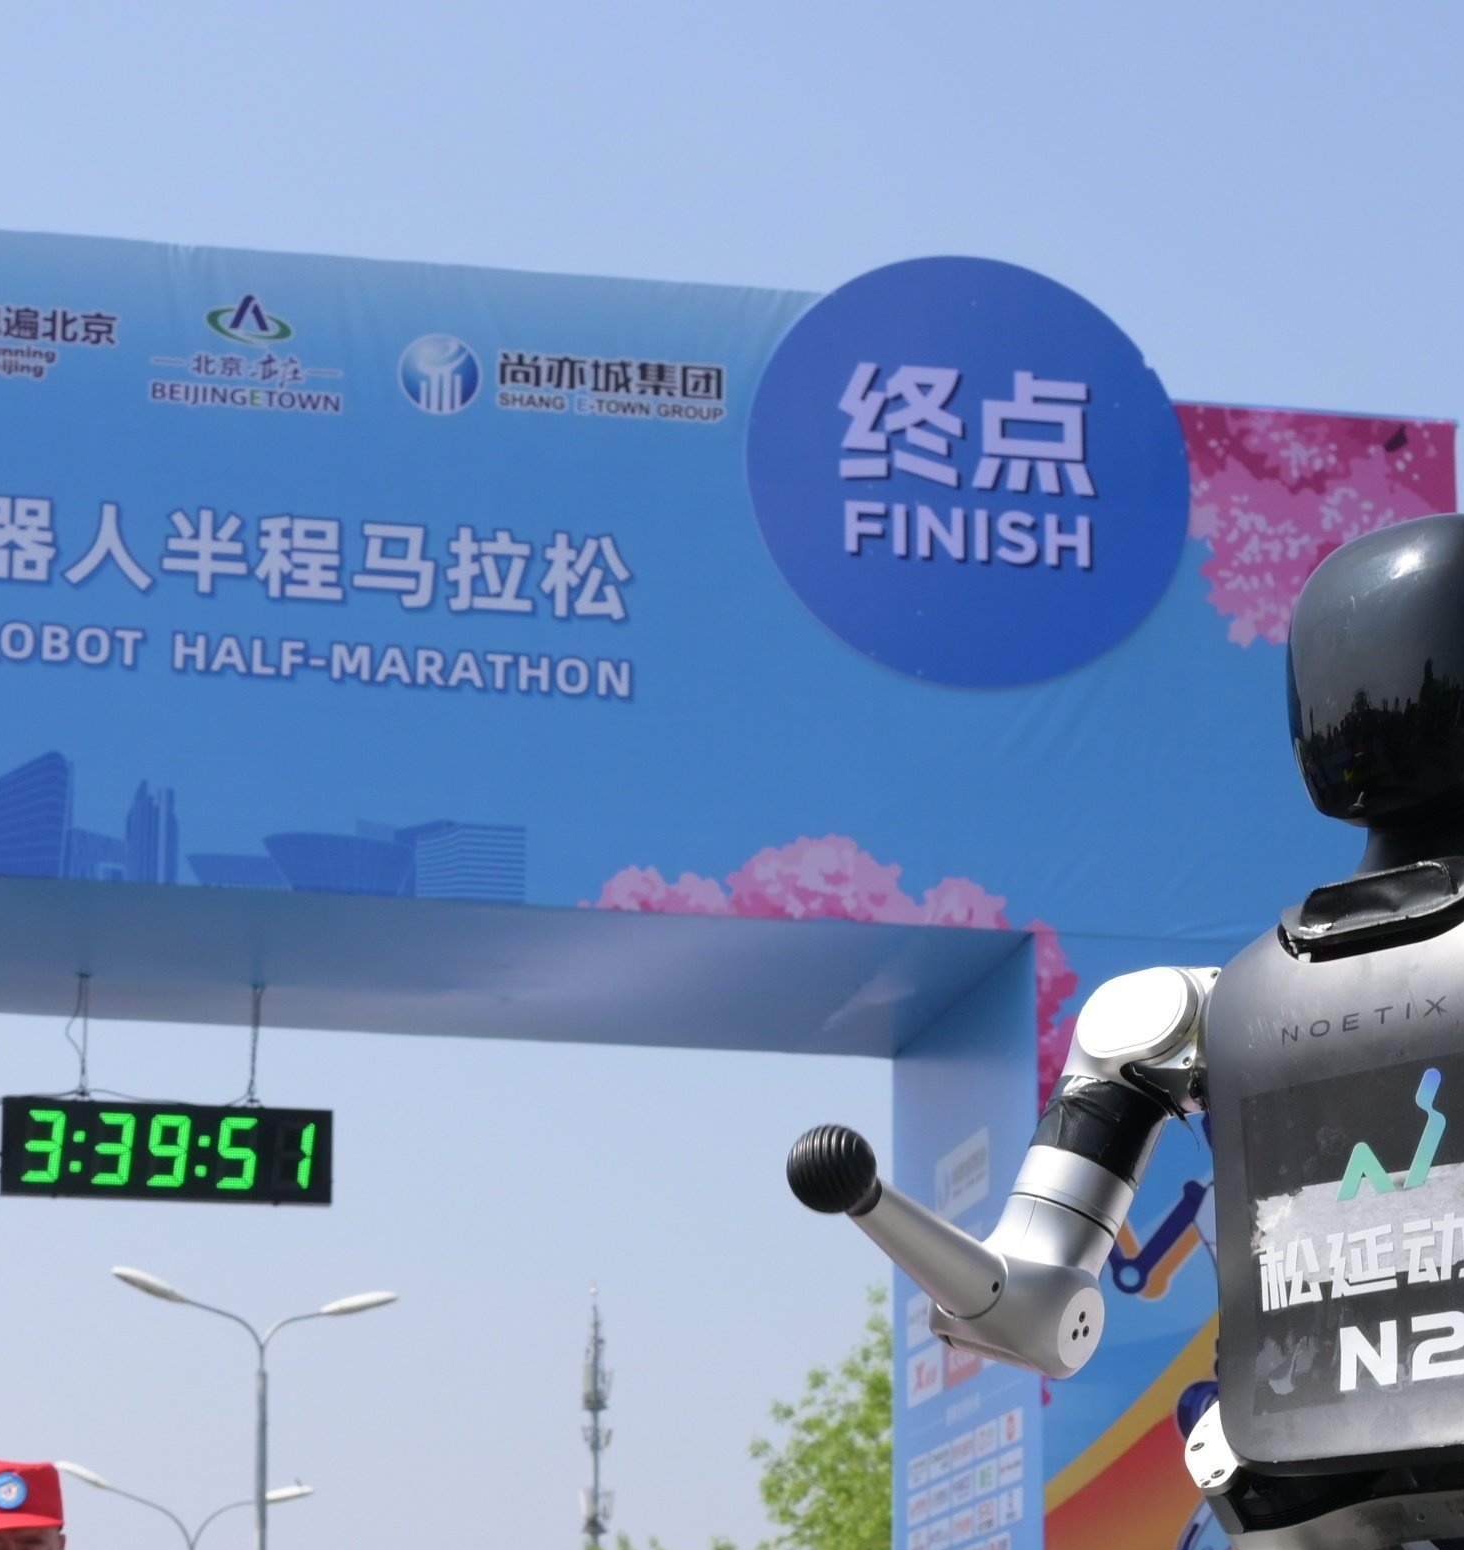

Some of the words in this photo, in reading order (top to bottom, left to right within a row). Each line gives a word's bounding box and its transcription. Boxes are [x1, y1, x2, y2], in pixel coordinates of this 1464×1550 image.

[151, 382, 341, 412] BEIJINGETOWN
[499, 353, 723, 401] 尚亦城集团
[499, 392, 566, 411] SHANG
[657, 403, 725, 421] GROUP
[839, 361, 1098, 498] 终点
[843, 500, 1094, 570] FINISH
[172, 632, 633, 698] HALF-MARATHON
[1281, 995, 1448, 1045] NOETIX
[21, 1109, 316, 1190] 3:39:51
